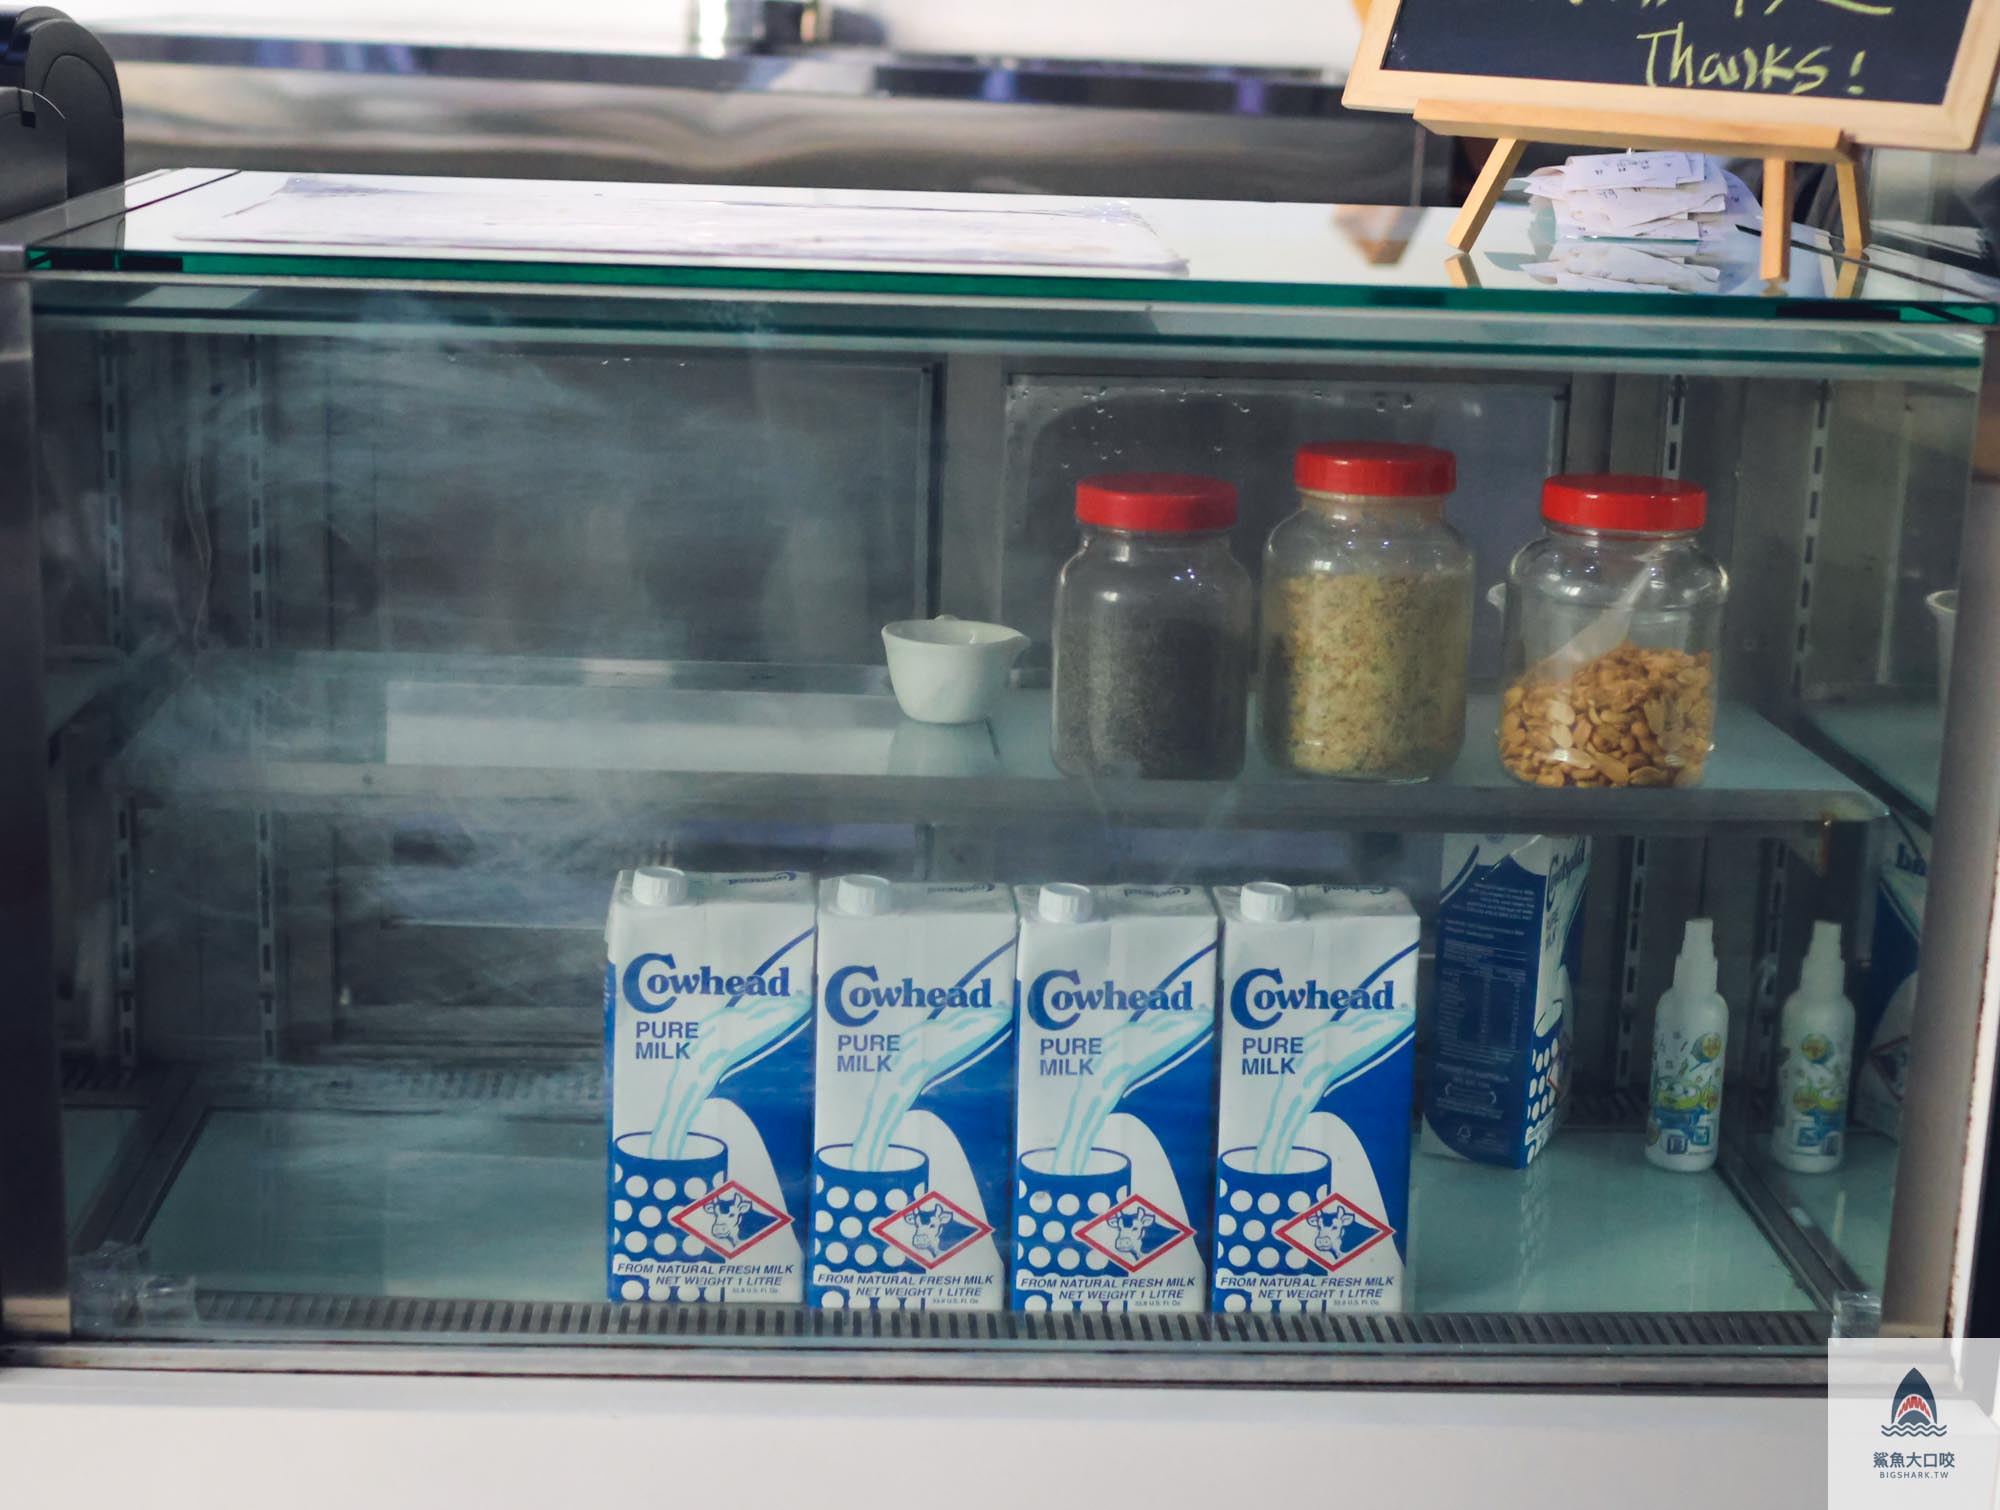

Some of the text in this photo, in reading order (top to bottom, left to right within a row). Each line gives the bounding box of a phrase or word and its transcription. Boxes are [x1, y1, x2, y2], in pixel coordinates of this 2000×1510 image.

[623, 953, 790, 1014] Cowhead
[825, 965, 992, 1027] Cowhead
[1028, 969, 1193, 1031] Cowhead
[1230, 968, 1395, 1030] Cowhead
[636, 1021, 699, 1038] PURE
[635, 1042, 691, 1059] MILK
[838, 1034, 900, 1051] PURE
[1040, 1037, 1102, 1055] PURE
[1242, 1037, 1303, 1054] PURE
[837, 1055, 892, 1072] MILK
[1039, 1058, 1093, 1076] MILK
[1241, 1057, 1296, 1075] MILK
[617, 1263, 795, 1275] FROM NATURAL FRESH MILK
[656, 1276, 783, 1286] NET WEIGHT 1 LITRE
[817, 1273, 994, 1285] FROM NATURAL FRESH MILK
[1021, 1277, 1196, 1288] FROM NATURAL FRESH MILK
[1220, 1276, 1394, 1287] FROM NATURAL FRESH MILK
[856, 1287, 983, 1297] NET WEIGHT 1 LITRE
[1059, 1289, 1185, 1300] NET WEIGHT 1 LITRE
[1258, 1288, 1384, 1299] NET WEIGHT 1 LITRE
